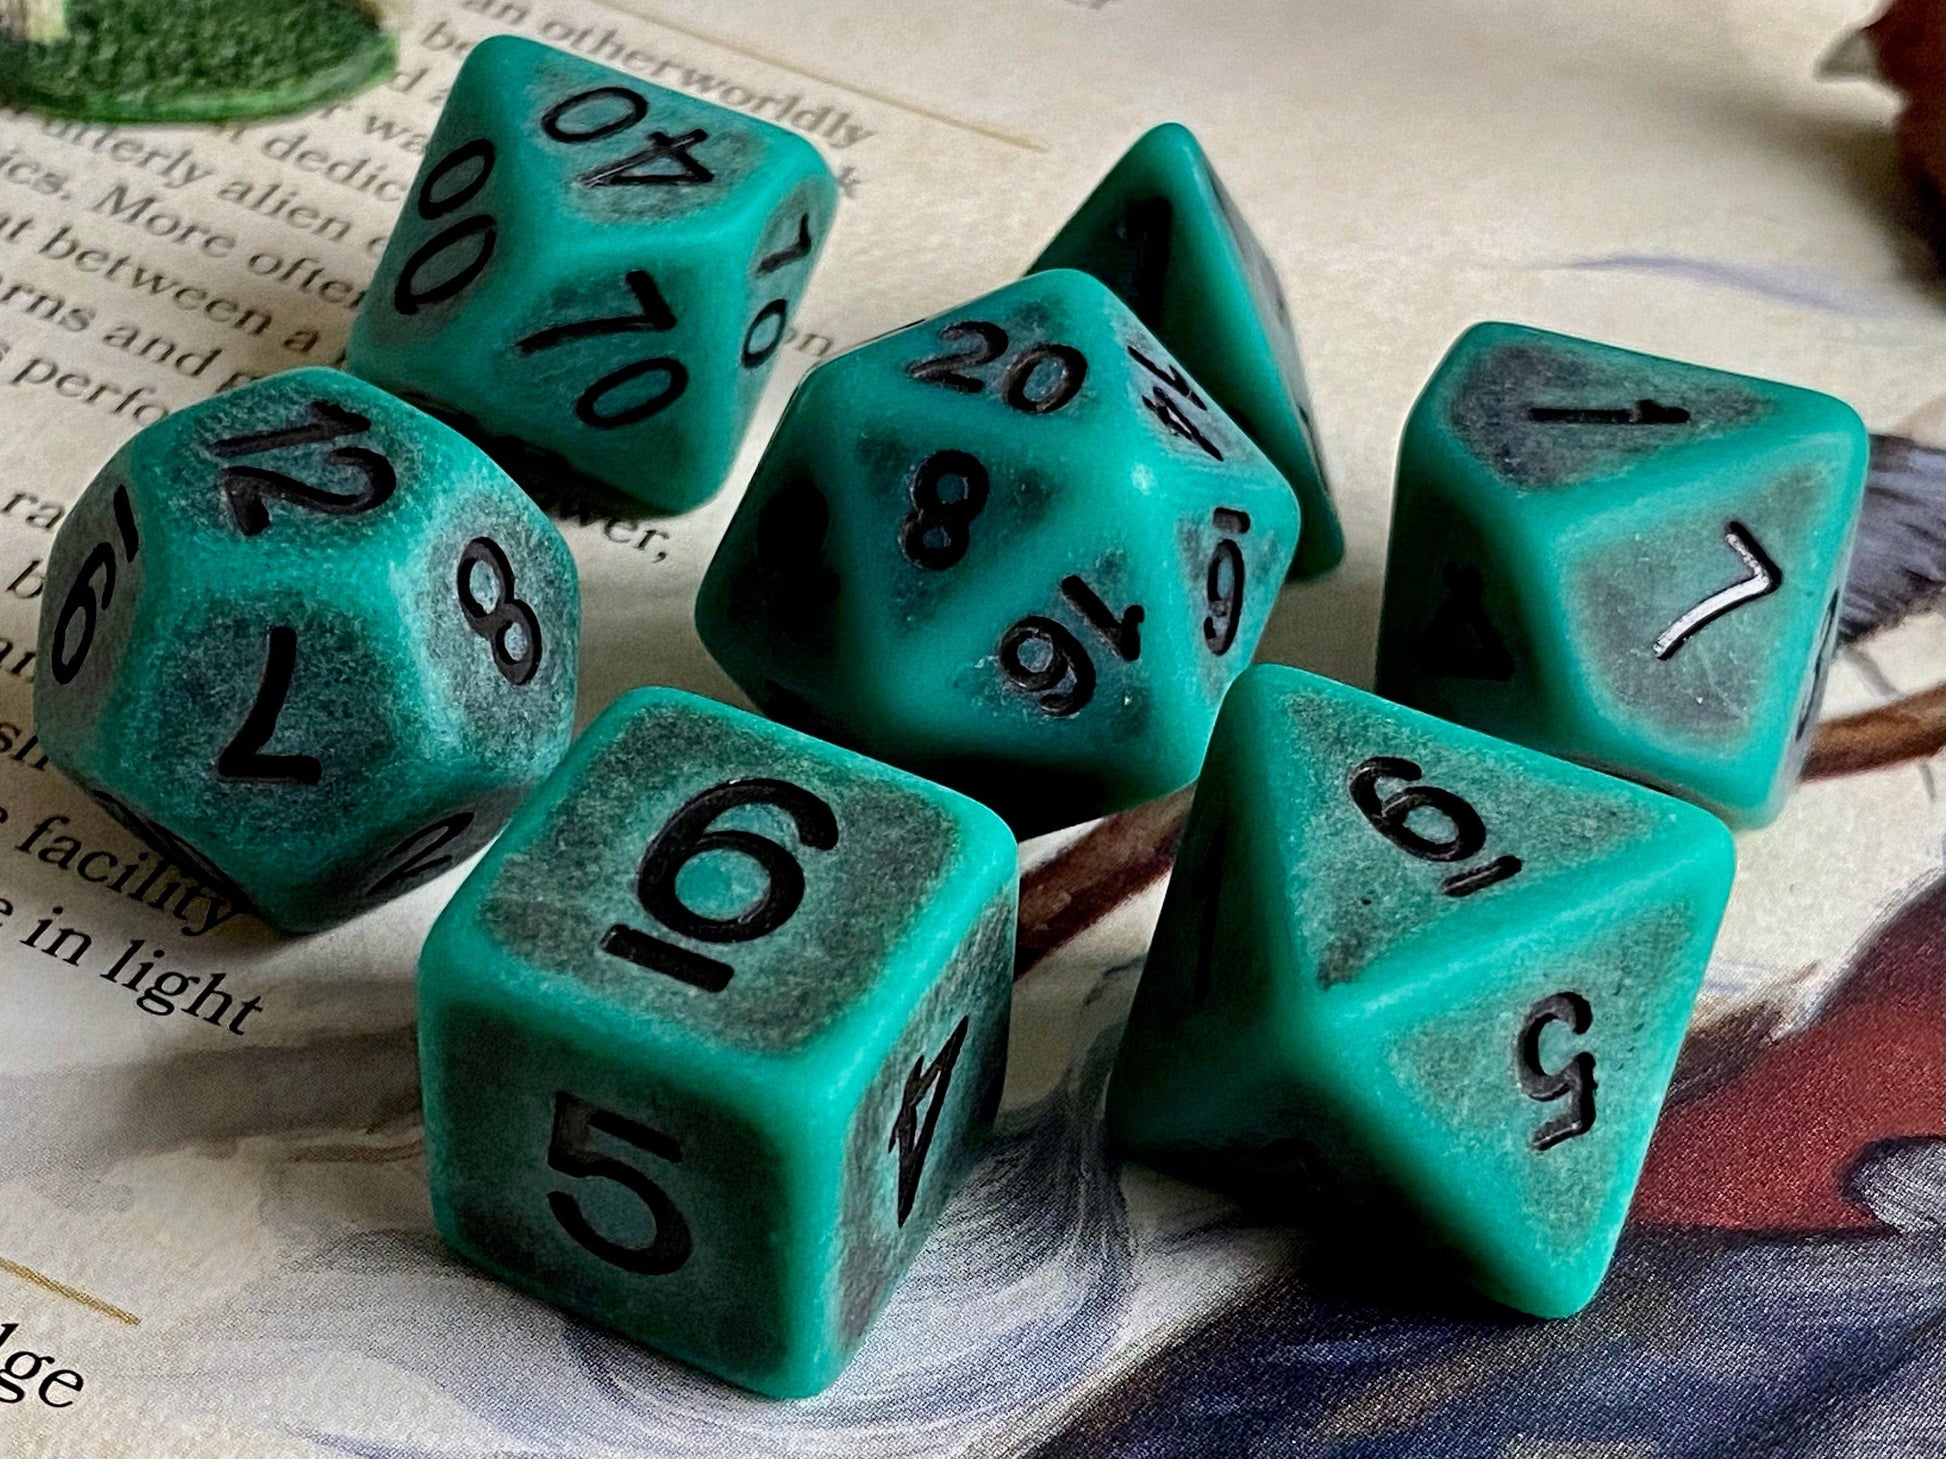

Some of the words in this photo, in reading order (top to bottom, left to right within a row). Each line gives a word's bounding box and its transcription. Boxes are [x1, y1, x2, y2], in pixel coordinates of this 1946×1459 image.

[538, 20, 877, 149] otherworldly
[38, 225, 273, 336] between
[91, 180, 237, 258] More
[394, 137, 497, 315] 00
[0, 282, 96, 332] rns
[102, 325, 223, 377] and
[907, 321, 1089, 415] 20
[206, 400, 397, 537] 12
[901, 449, 990, 571] 8
[457, 536, 542, 686] 8
[1653, 520, 1782, 660] 7
[217, 626, 322, 786] 7
[15, 814, 240, 937] facility
[600, 776, 839, 994] 6
[19, 907, 93, 967] in
[100, 938, 264, 1036] light
[1515, 991, 1598, 1153] 5
[547, 1091, 693, 1277] 5
